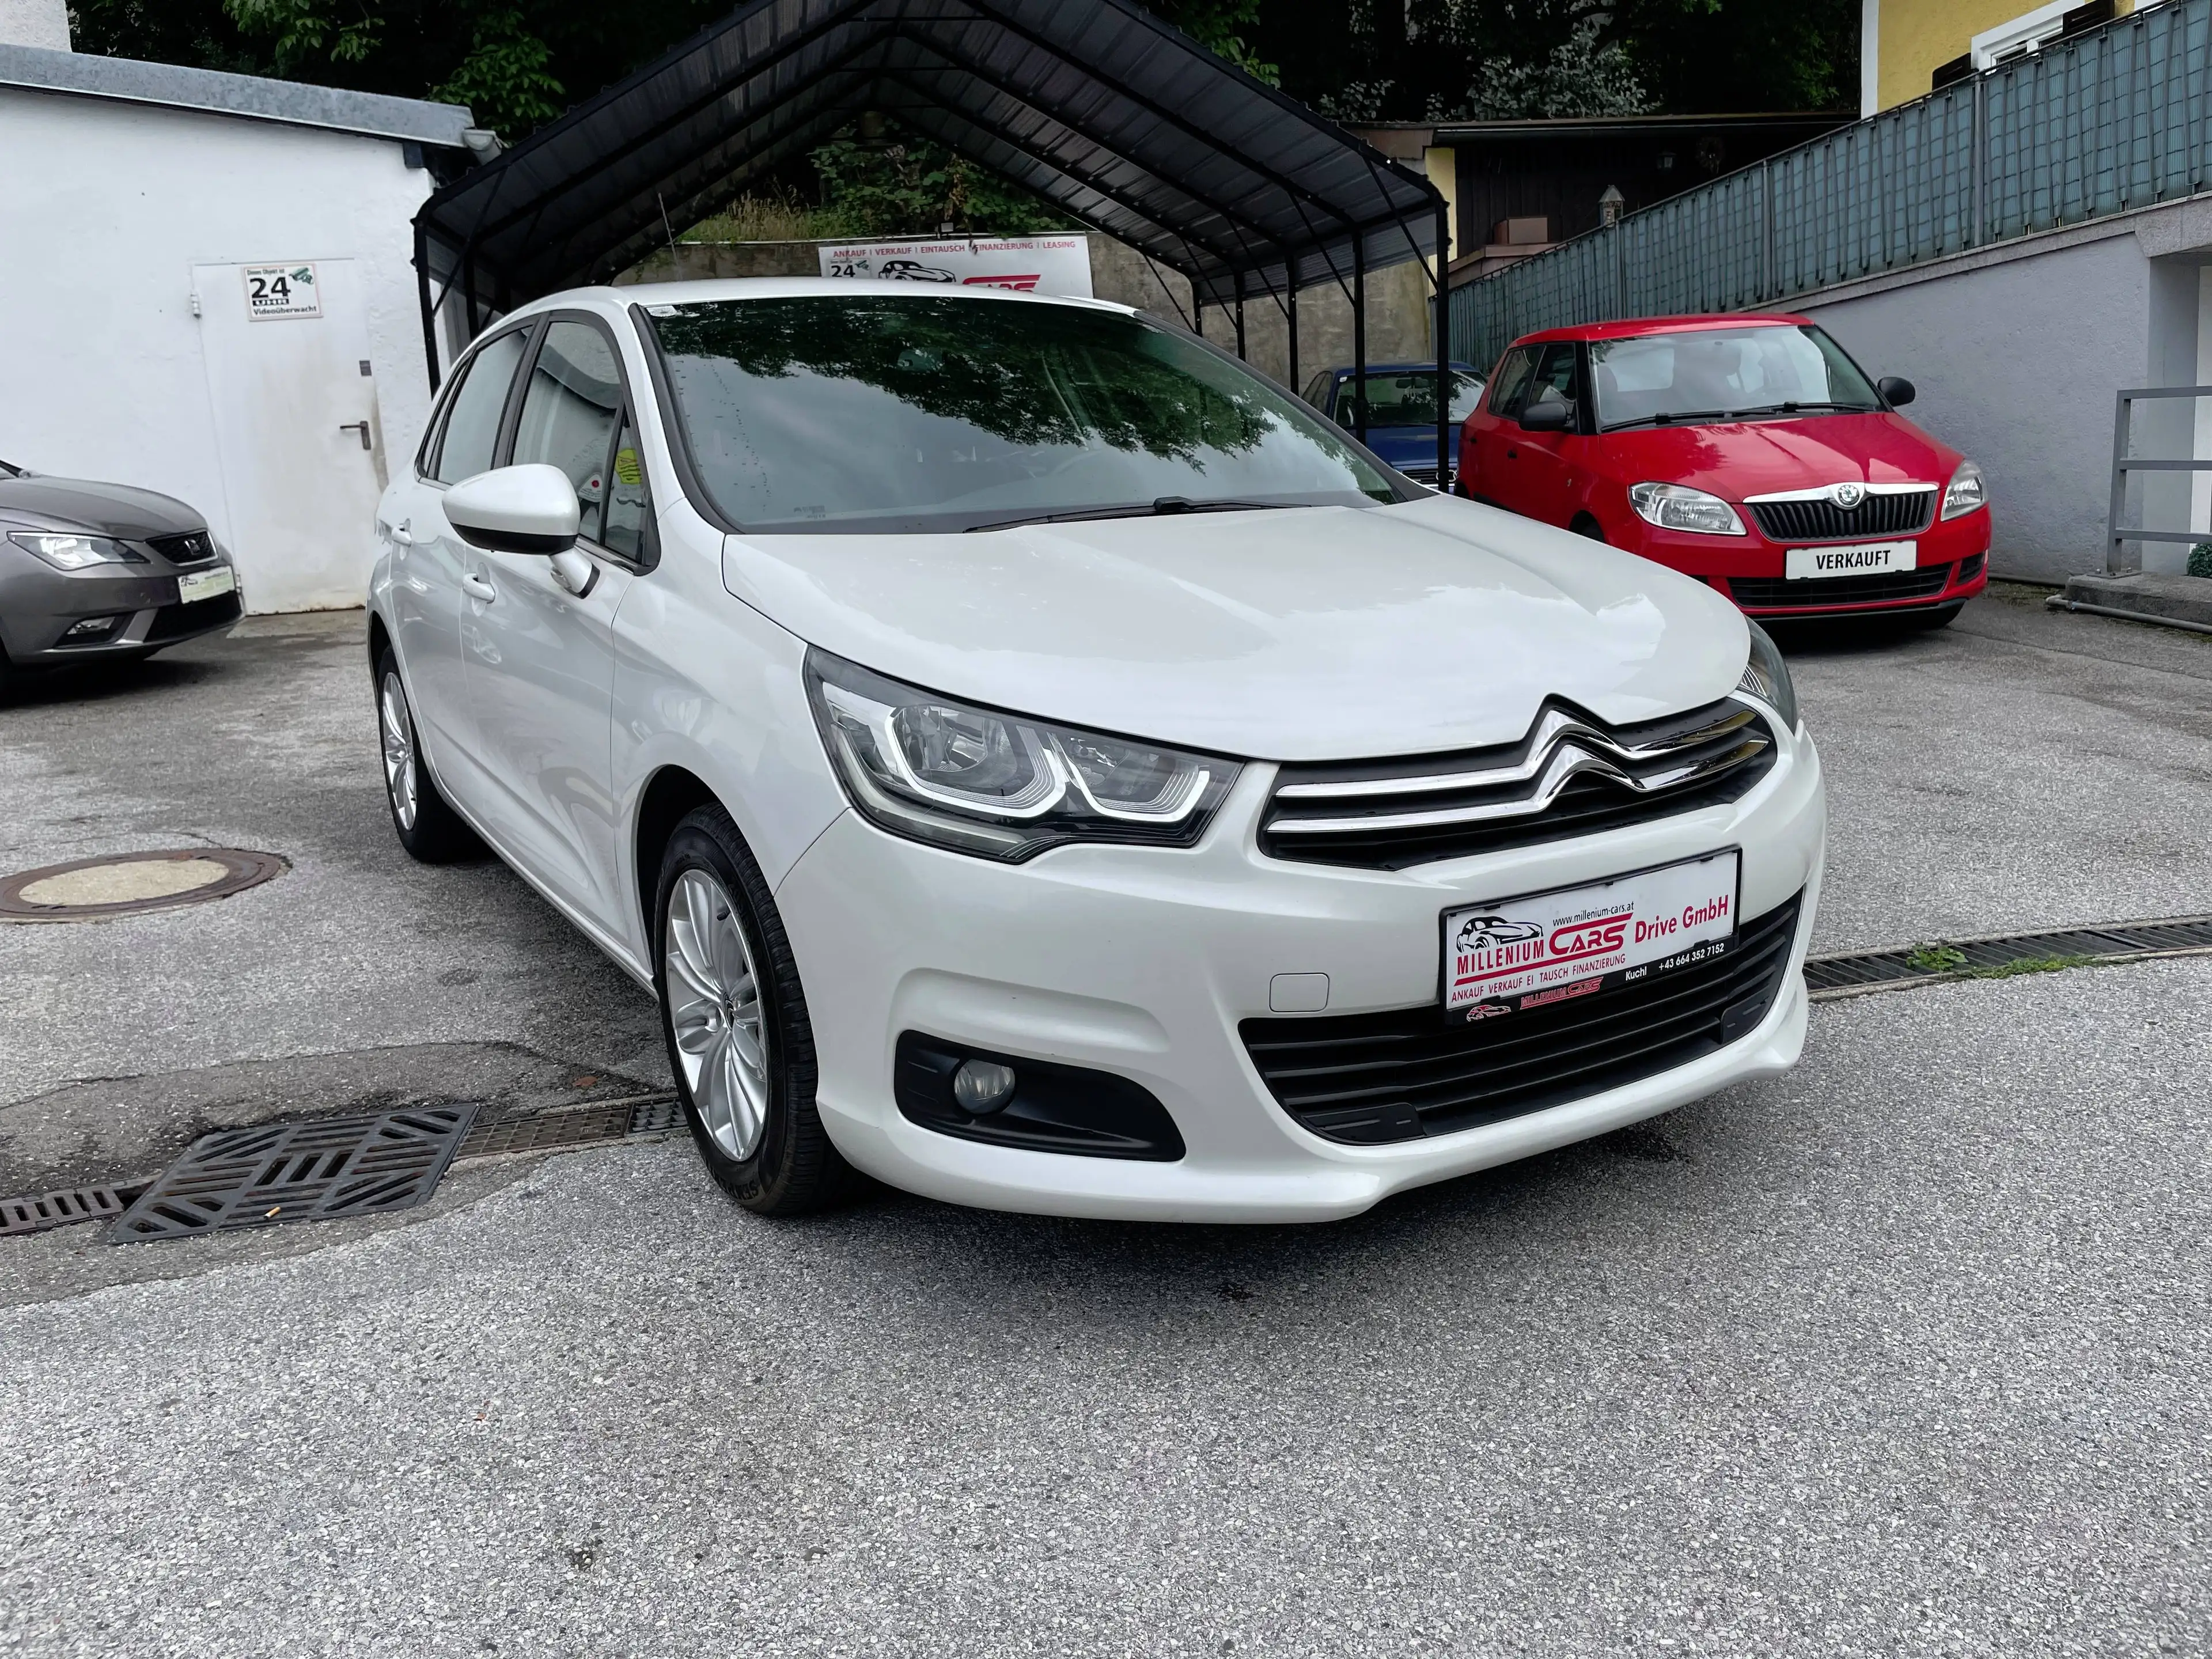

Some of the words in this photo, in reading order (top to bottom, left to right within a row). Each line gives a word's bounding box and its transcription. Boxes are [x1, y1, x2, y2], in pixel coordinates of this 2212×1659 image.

[833, 249, 866, 258] ANKAUF
[874, 247, 912, 255] VERKAUF
[921, 245, 965, 254] EINTAUSCH
[975, 242, 1034, 251] FINANZIERUNG
[831, 264, 856, 278] 24
[249, 276, 291, 298] 24
[253, 306, 317, 315] Videoüberwacht
[1816, 550, 1891, 570] VERKAUFT
[1552, 901, 1634, 927] www.millenium-cars.at
[1457, 939, 1544, 975] MILLENIUM
[1549, 912, 1634, 956] CARS
[1635, 915, 1677, 944] Drive
[1683, 895, 1729, 929] GmbH
[1625, 966, 1647, 981] Kuchl
[1658, 959, 1674, 971] +43
[1676, 953, 1690, 966] 664
[1691, 949, 1705, 961] 352
[1707, 942, 1725, 957] 7152
[1452, 986, 1484, 1003] ANKAUF
[1488, 977, 1523, 994] VERKAUF
[1540, 967, 1569, 983] TAUSCH
[1573, 953, 1626, 975] FINANZIERUNG
[1521, 987, 1567, 1007] MILLENIUM
[1567, 976, 1604, 995] CARS
